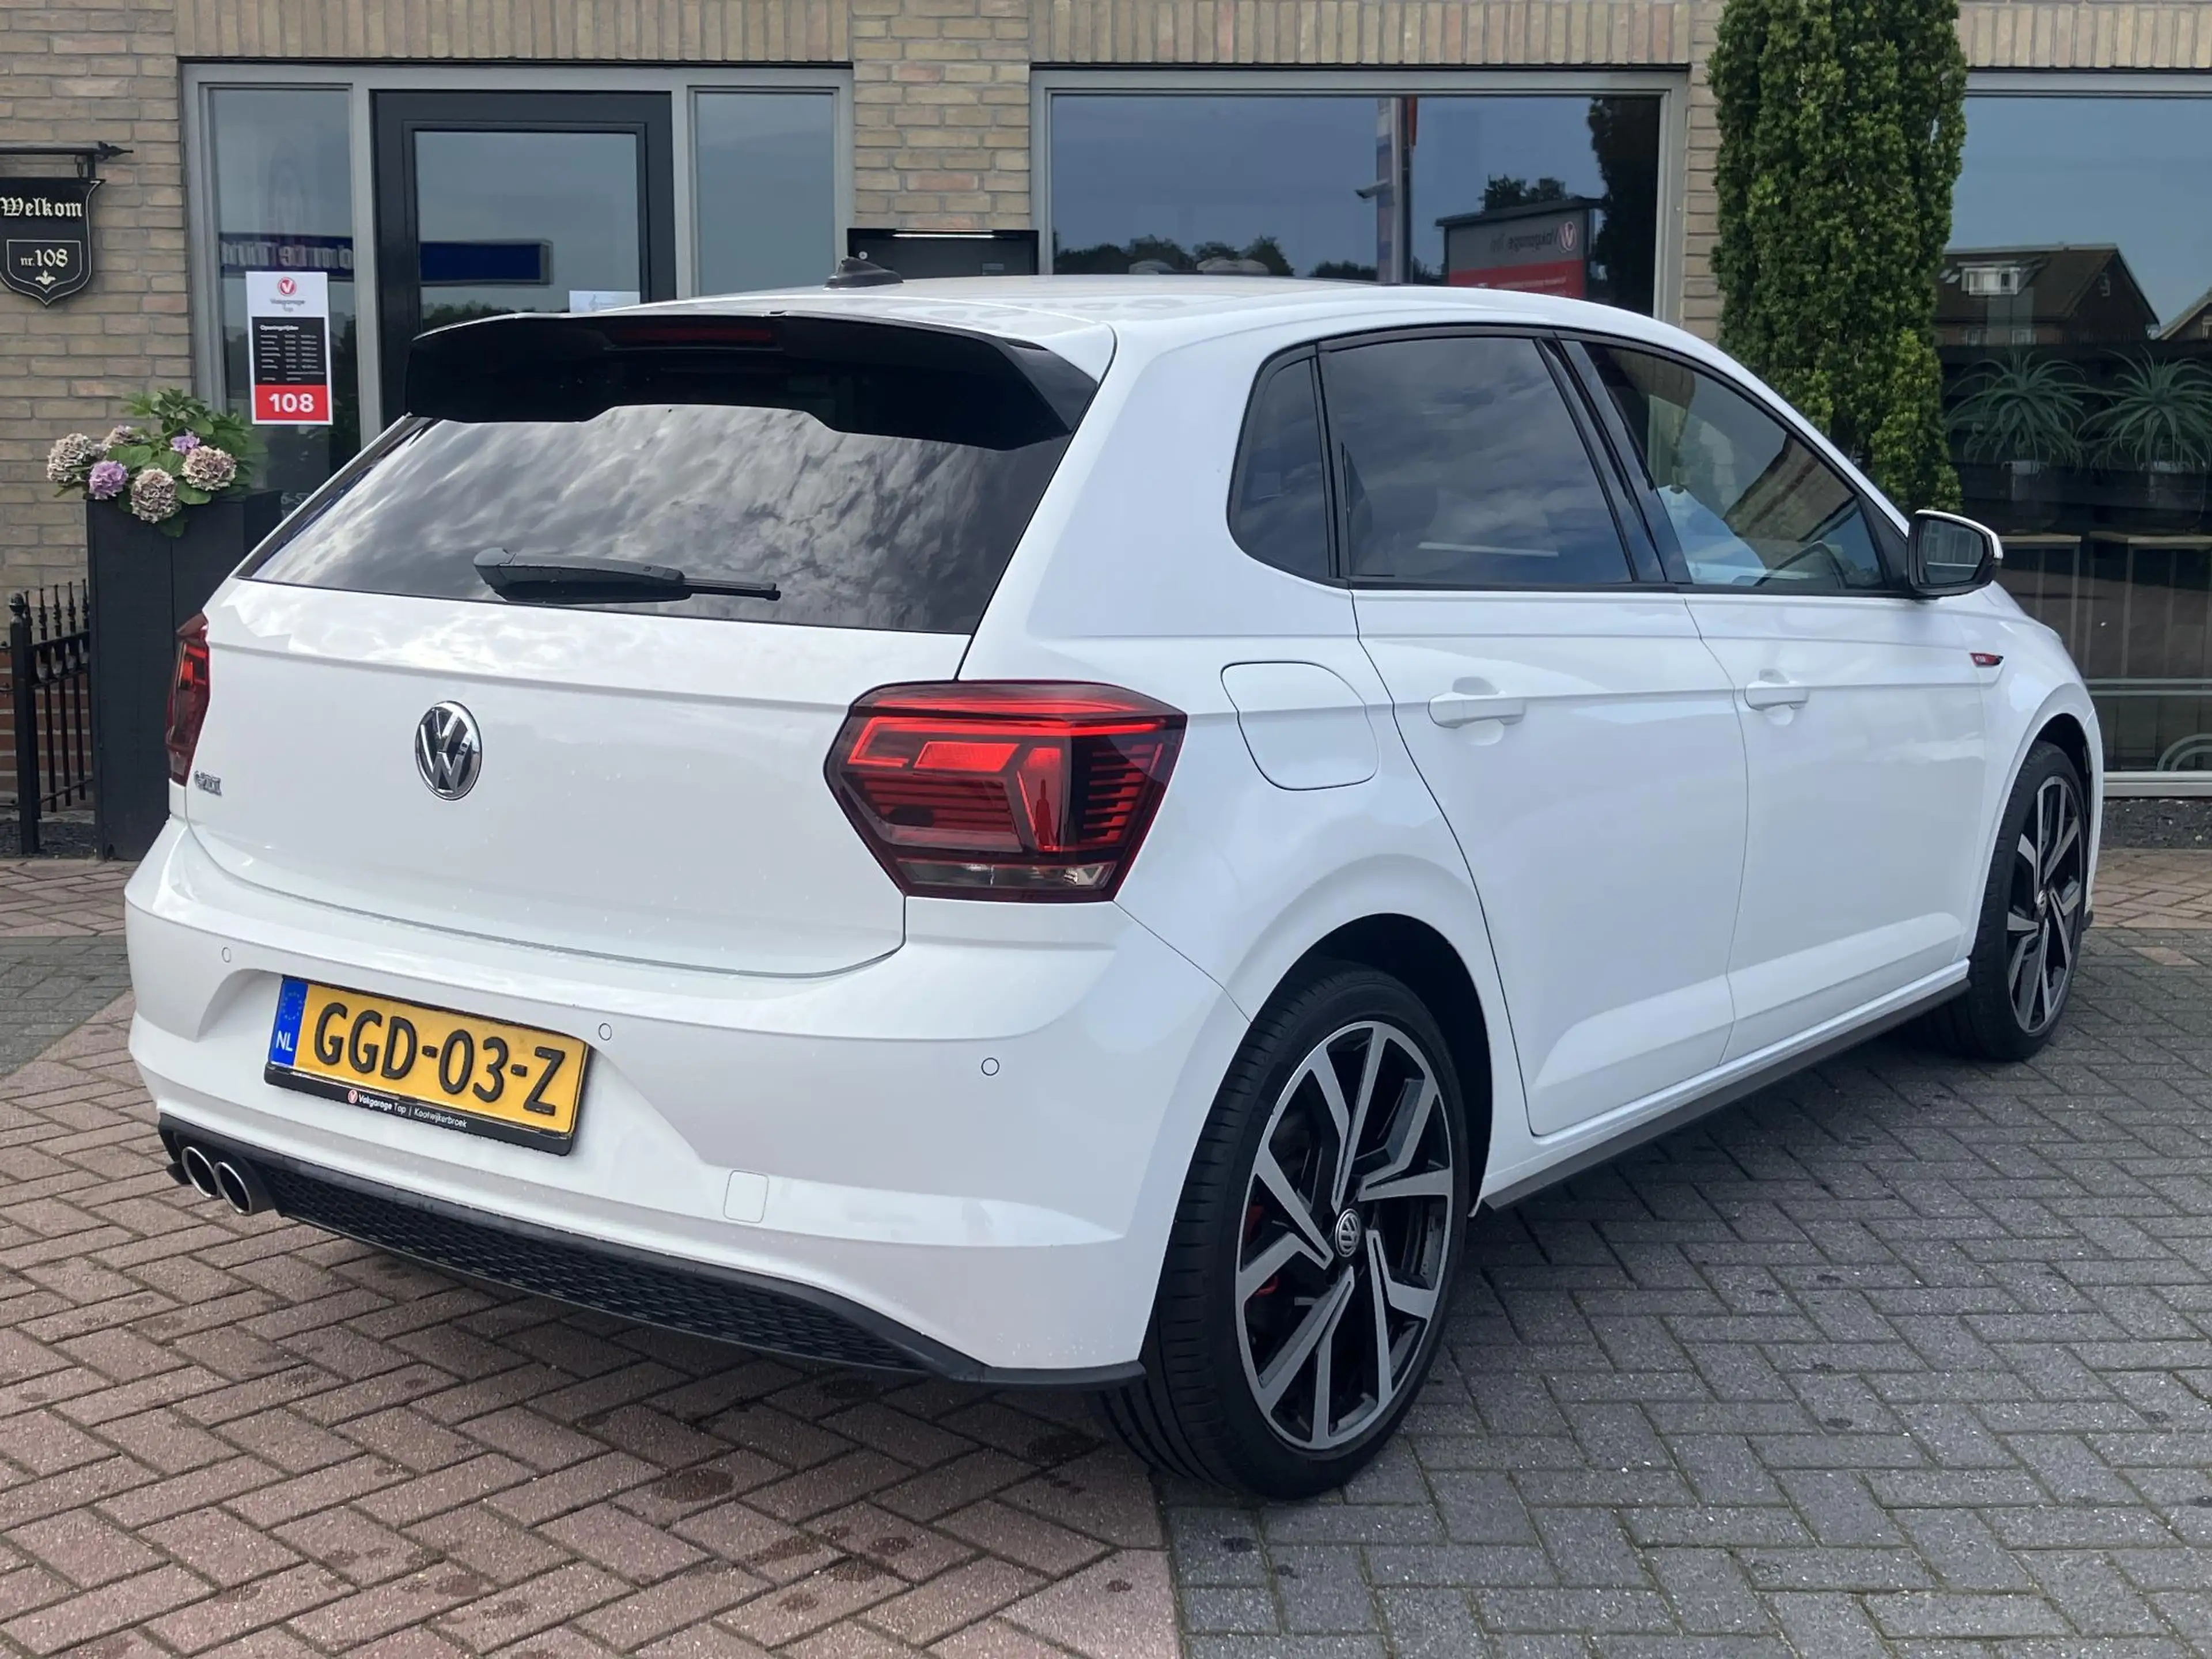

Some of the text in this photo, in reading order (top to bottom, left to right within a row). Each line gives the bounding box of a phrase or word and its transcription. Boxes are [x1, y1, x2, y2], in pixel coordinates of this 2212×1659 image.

[0, 197, 82, 217] Welkom
[268, 393, 315, 413] 108
[275, 1030, 293, 1051] NL
[314, 1002, 565, 1116] GGD-03-Z
[358, 1094, 393, 1111] Vakgarage
[393, 1103, 407, 1114] Top
[414, 1107, 468, 1128] Kootwijkerbroek
